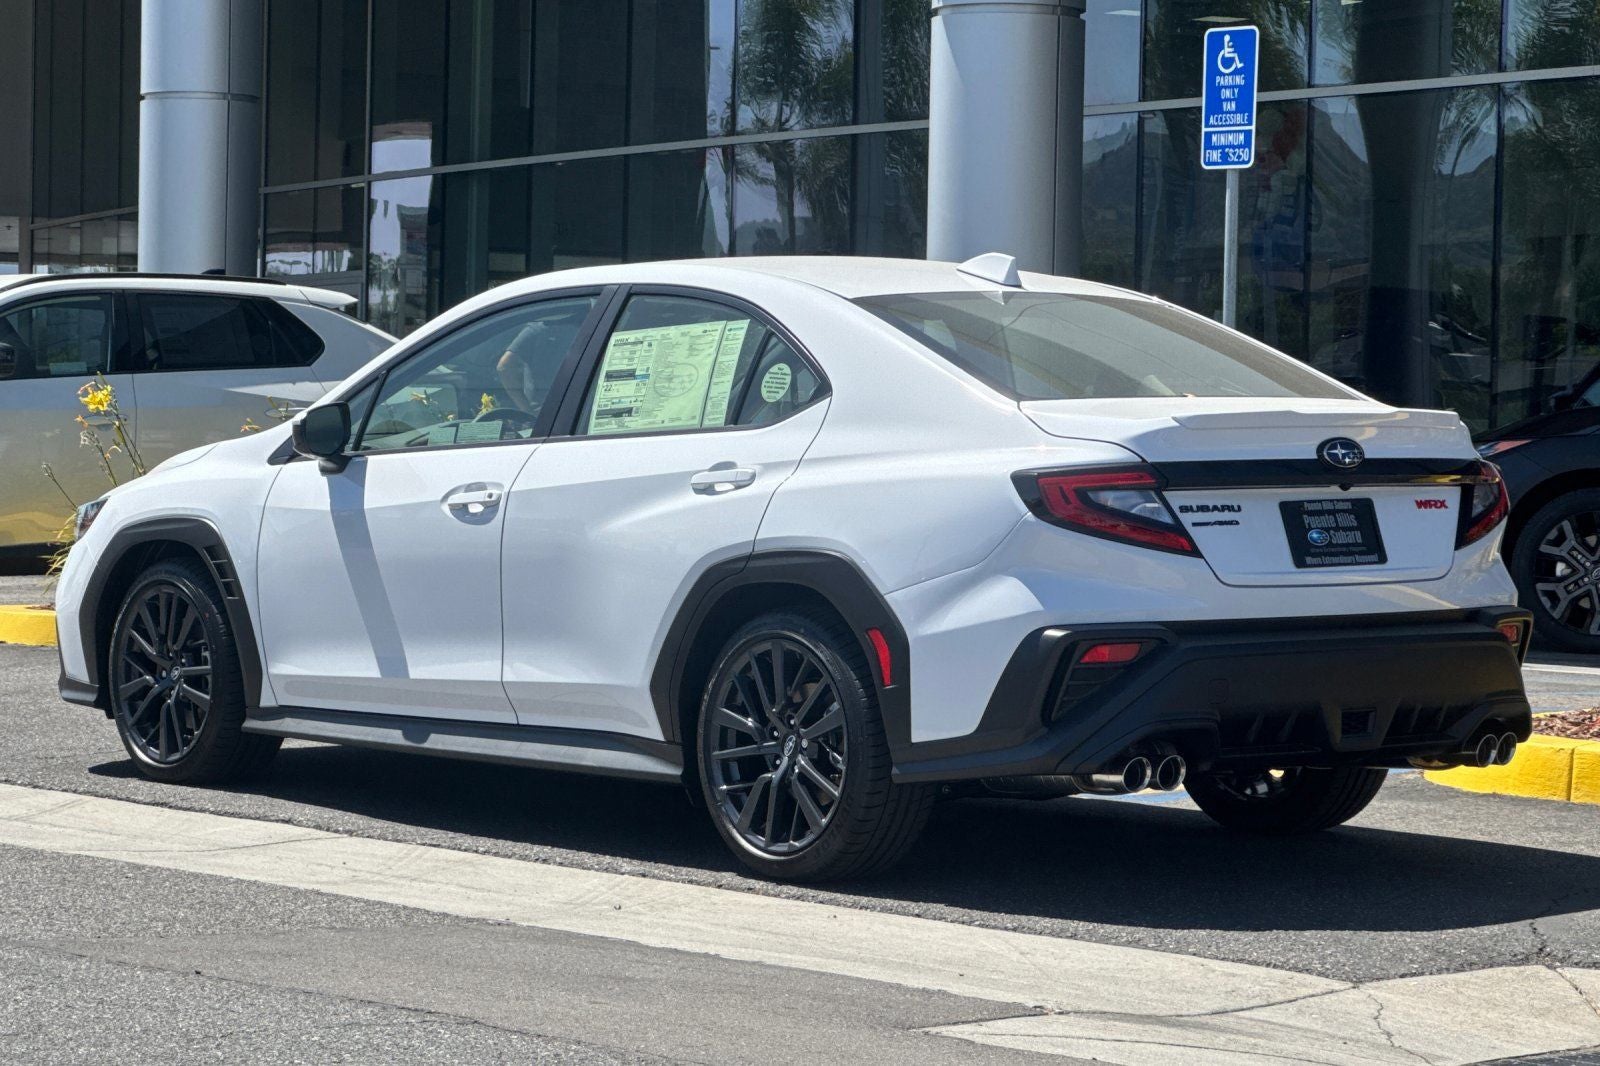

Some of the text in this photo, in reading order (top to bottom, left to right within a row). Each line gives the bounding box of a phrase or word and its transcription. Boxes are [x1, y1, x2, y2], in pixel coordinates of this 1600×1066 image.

[1216, 74, 1245, 86] PARKING
[1220, 88, 1239, 99] ONLY
[1222, 100, 1236, 112] VAN
[1209, 113, 1249, 125] ACCESSIBLE
[1211, 132, 1245, 146] MINIMUM
[1206, 148, 1250, 163] FINE $250
[1179, 504, 1242, 513] SUBARU
[1414, 499, 1448, 509] WRX
[1303, 512, 1358, 528] Puente Hills
[1330, 530, 1362, 544] Subaru
